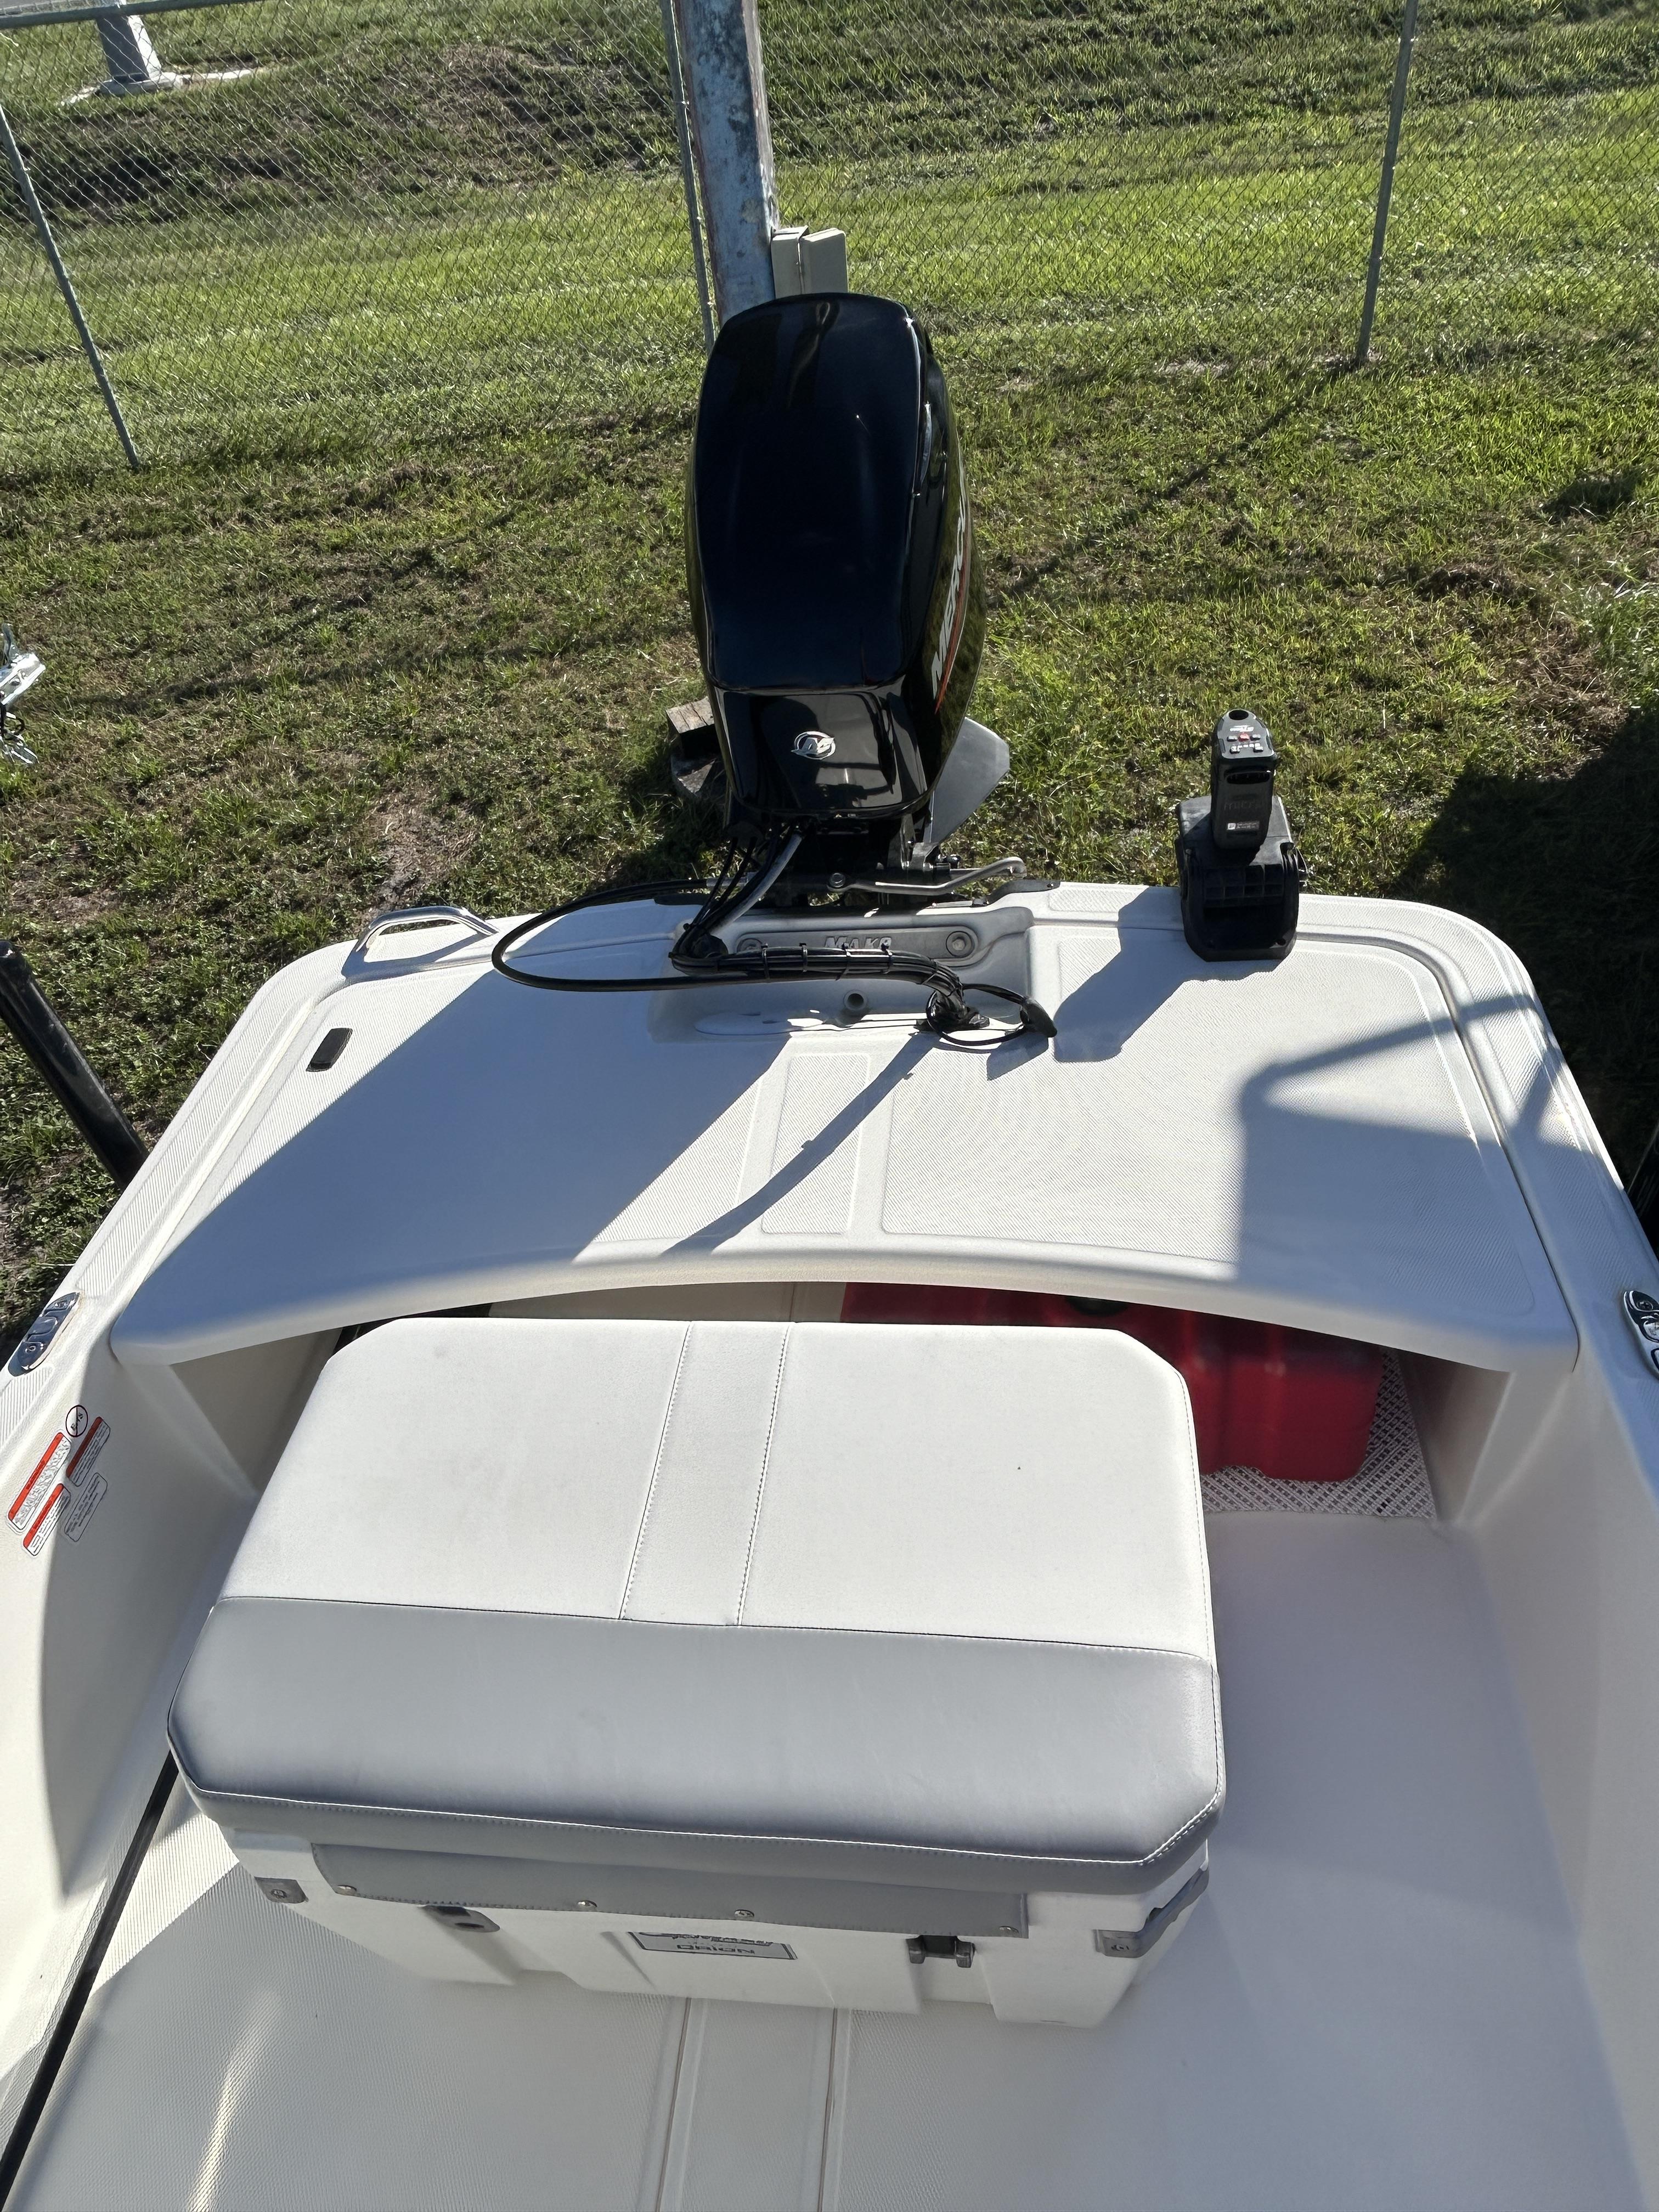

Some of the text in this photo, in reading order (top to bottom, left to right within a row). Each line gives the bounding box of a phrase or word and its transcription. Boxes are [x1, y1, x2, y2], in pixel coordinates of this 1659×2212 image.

[932, 447, 967, 699] MERCU
[825, 936, 892, 949] MAKO
[676, 1944, 755, 1954] ORION
